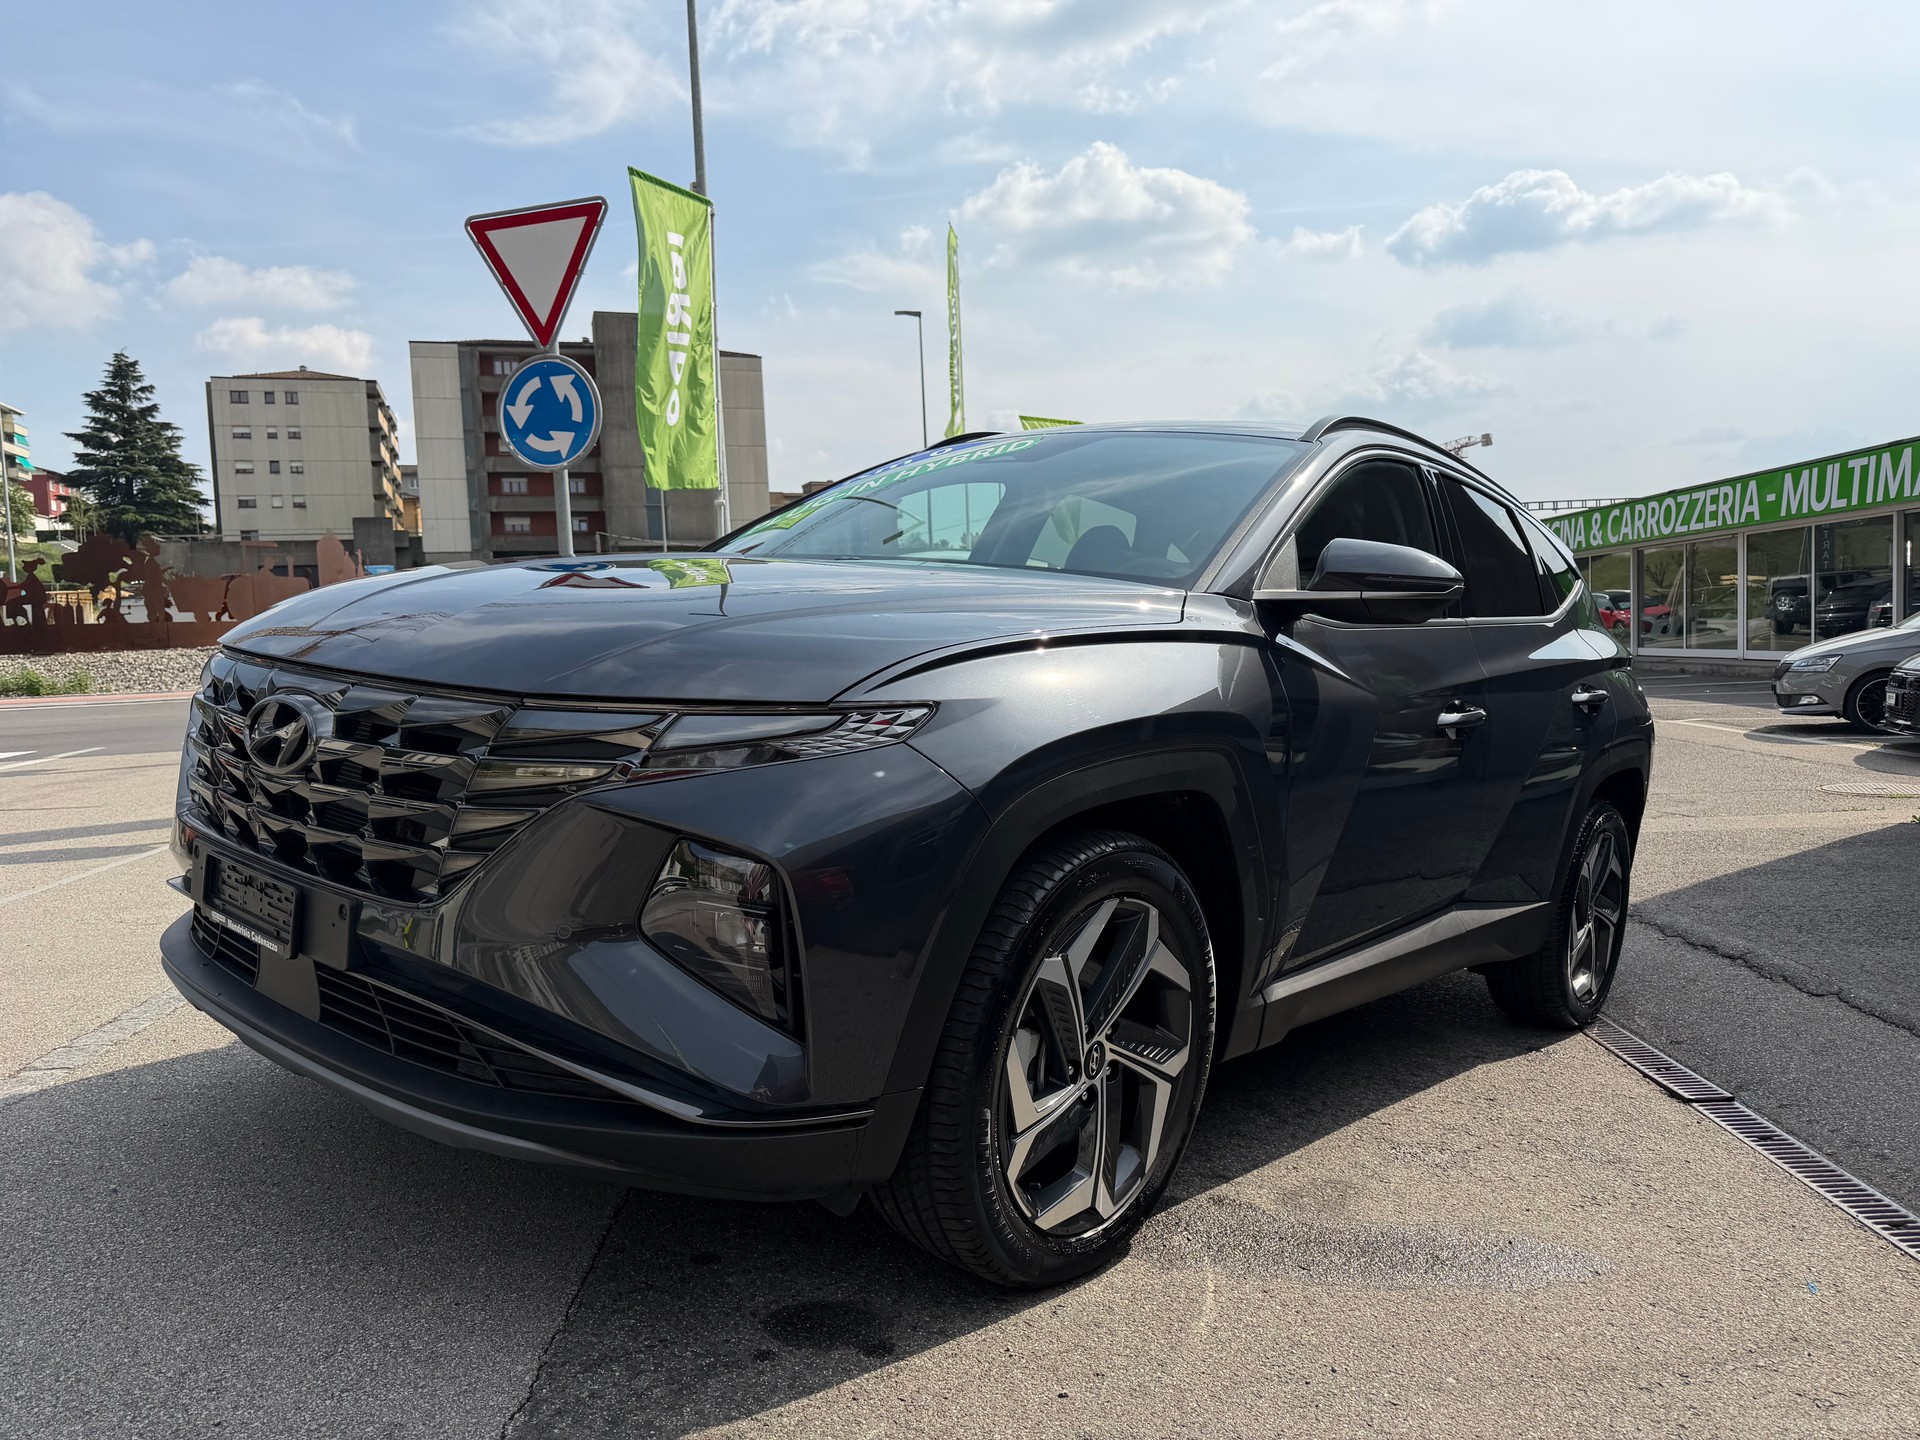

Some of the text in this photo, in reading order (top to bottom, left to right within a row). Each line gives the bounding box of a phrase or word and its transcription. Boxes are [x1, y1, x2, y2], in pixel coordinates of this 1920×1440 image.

[893, 439, 1035, 481] HYBRID
[1547, 516, 1586, 549] CINA
[1589, 512, 1603, 547] &
[1607, 480, 1760, 544] CARROZZERIA
